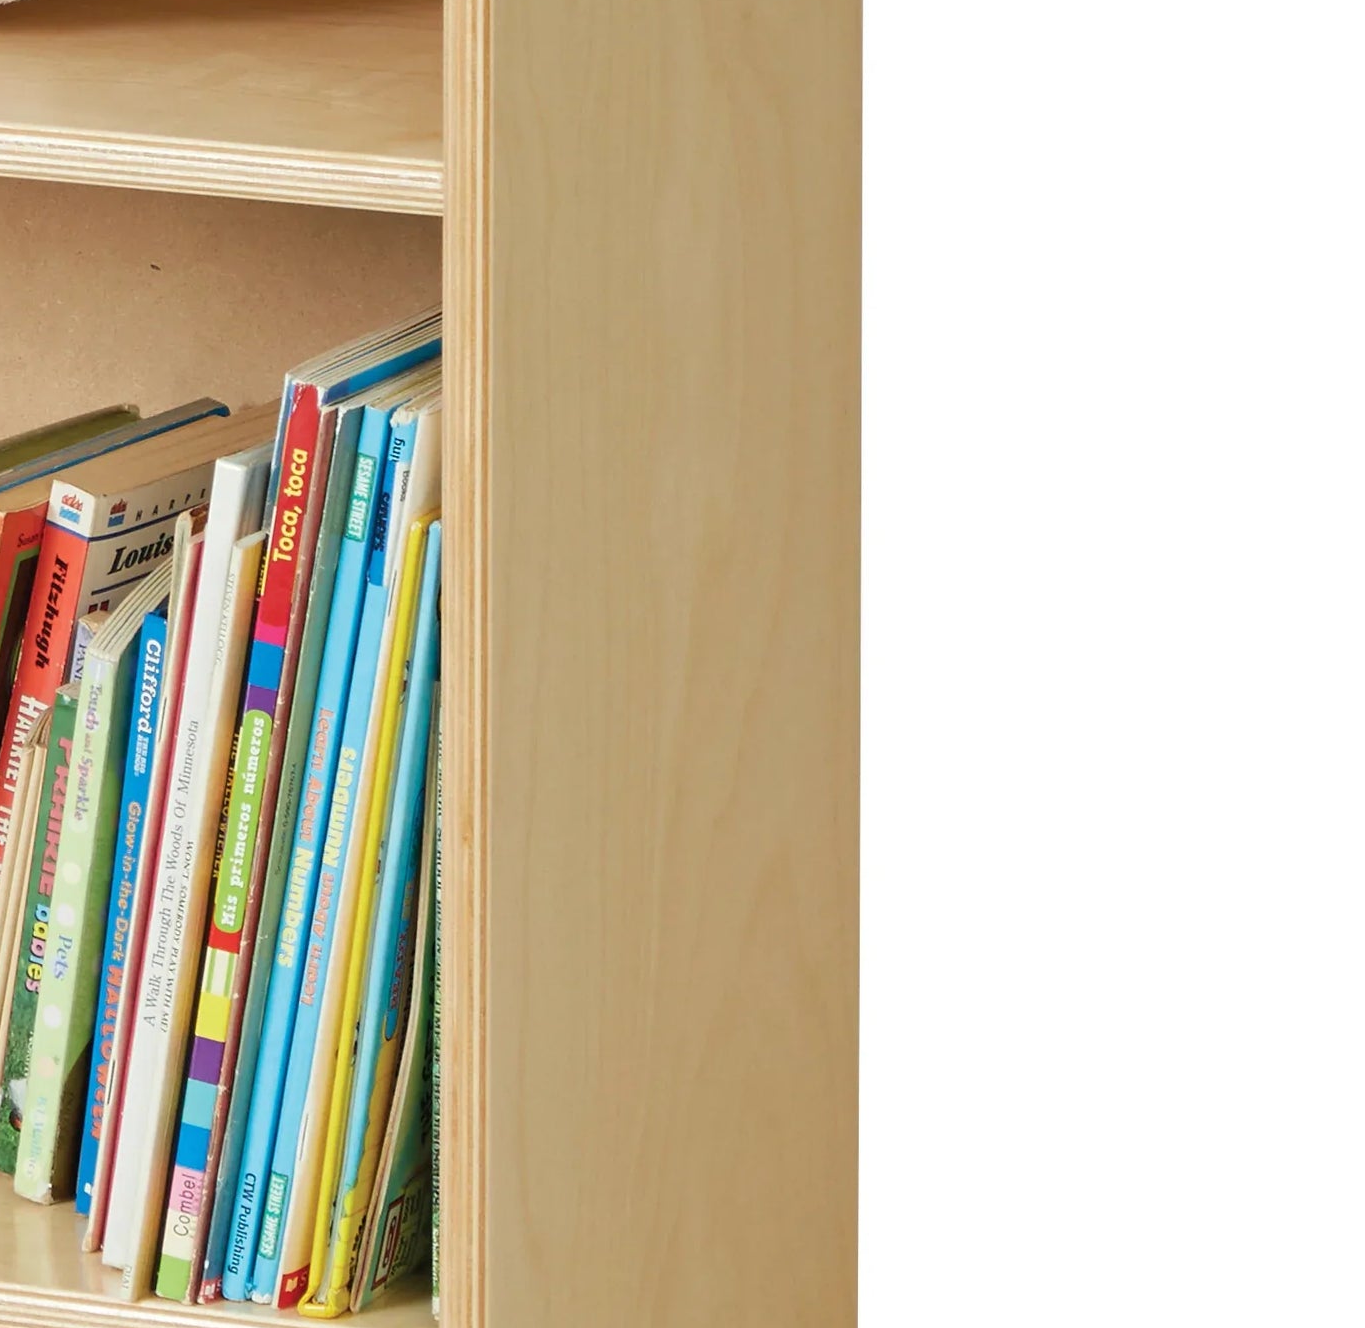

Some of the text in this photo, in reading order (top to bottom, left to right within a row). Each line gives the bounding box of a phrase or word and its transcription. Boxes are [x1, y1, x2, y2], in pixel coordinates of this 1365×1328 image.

[272, 448, 309, 562] Toca, toca
[347, 457, 373, 538] SESAME STREET
[34, 553, 69, 670] Fitzhugh
[136, 638, 162, 734] Clifford
[310, 707, 335, 770] Learn
[221, 894, 239, 927] Mis
[230, 803, 252, 889] primeros
[243, 716, 265, 795] números
[300, 775, 323, 842] About
[112, 801, 142, 962] Glow-in-the-Dark
[143, 720, 200, 1028] A Walk Through The Woods Of Minnesota
[276, 846, 314, 969] Numbers
[299, 746, 358, 1007] Learn About Numbers
[54, 934, 73, 981] Pets
[173, 1173, 197, 1237] Combel
[227, 1172, 257, 1276] CTW Publishing
[261, 1175, 288, 1257] SESAME STREET
